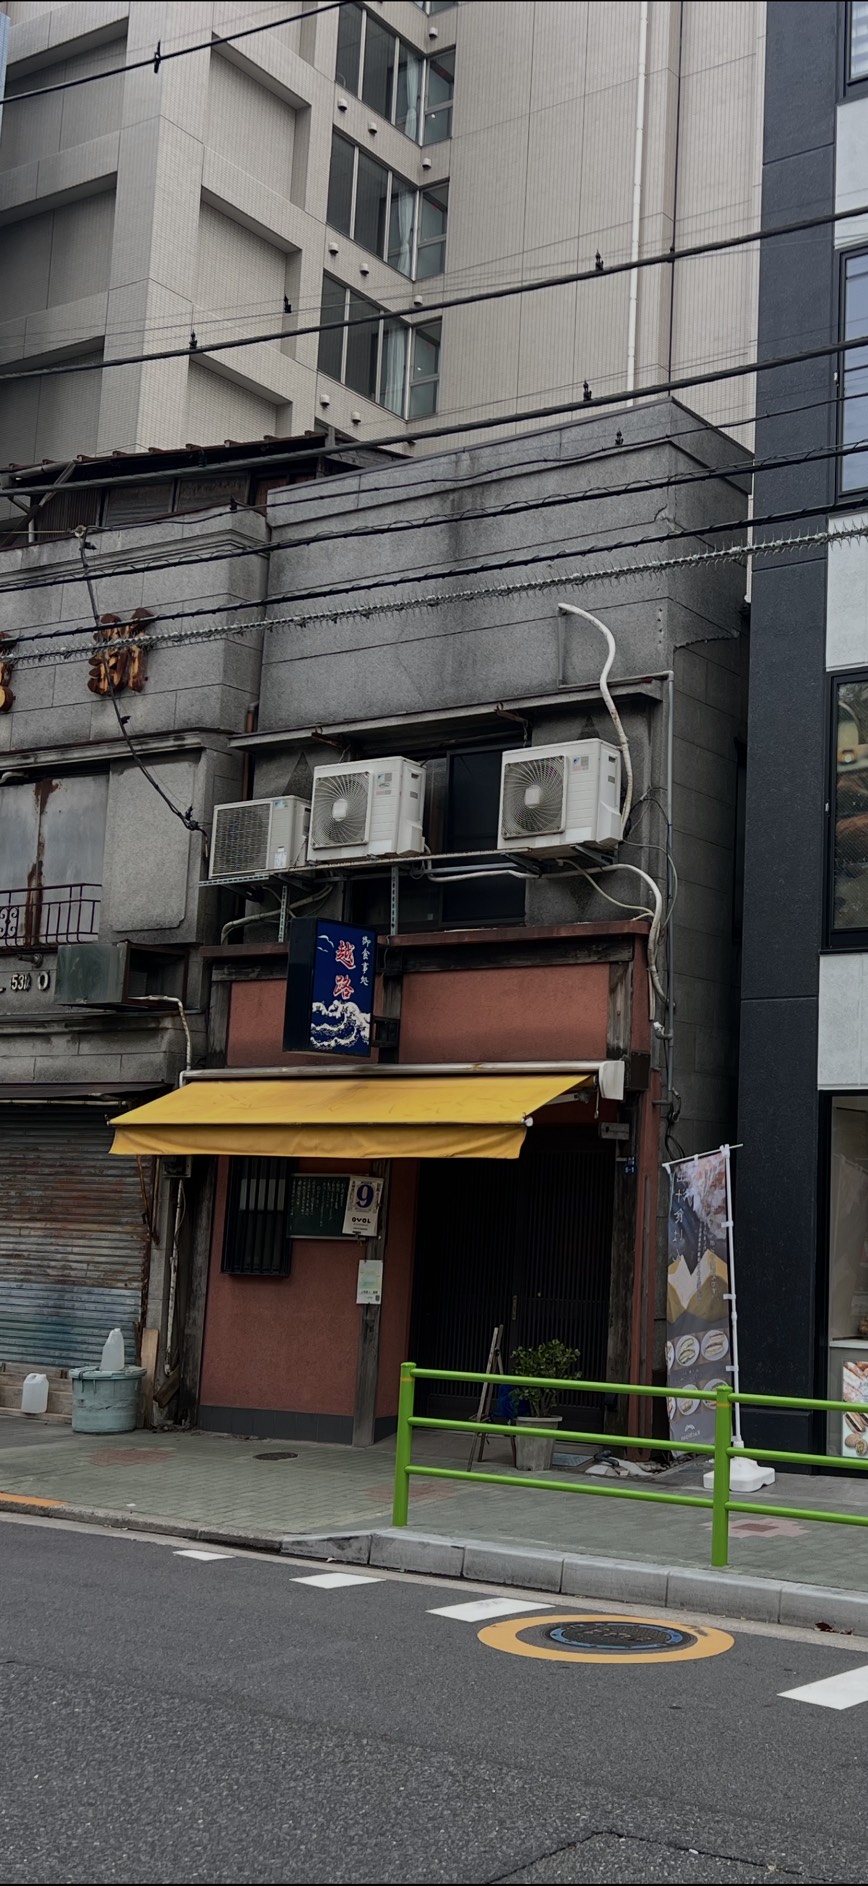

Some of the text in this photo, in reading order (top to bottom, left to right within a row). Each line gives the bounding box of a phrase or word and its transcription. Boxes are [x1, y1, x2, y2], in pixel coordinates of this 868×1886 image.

[333, 939, 356, 1000] 越路
[360, 935, 372, 986] 御食事処
[356, 1184, 374, 1208] 9
